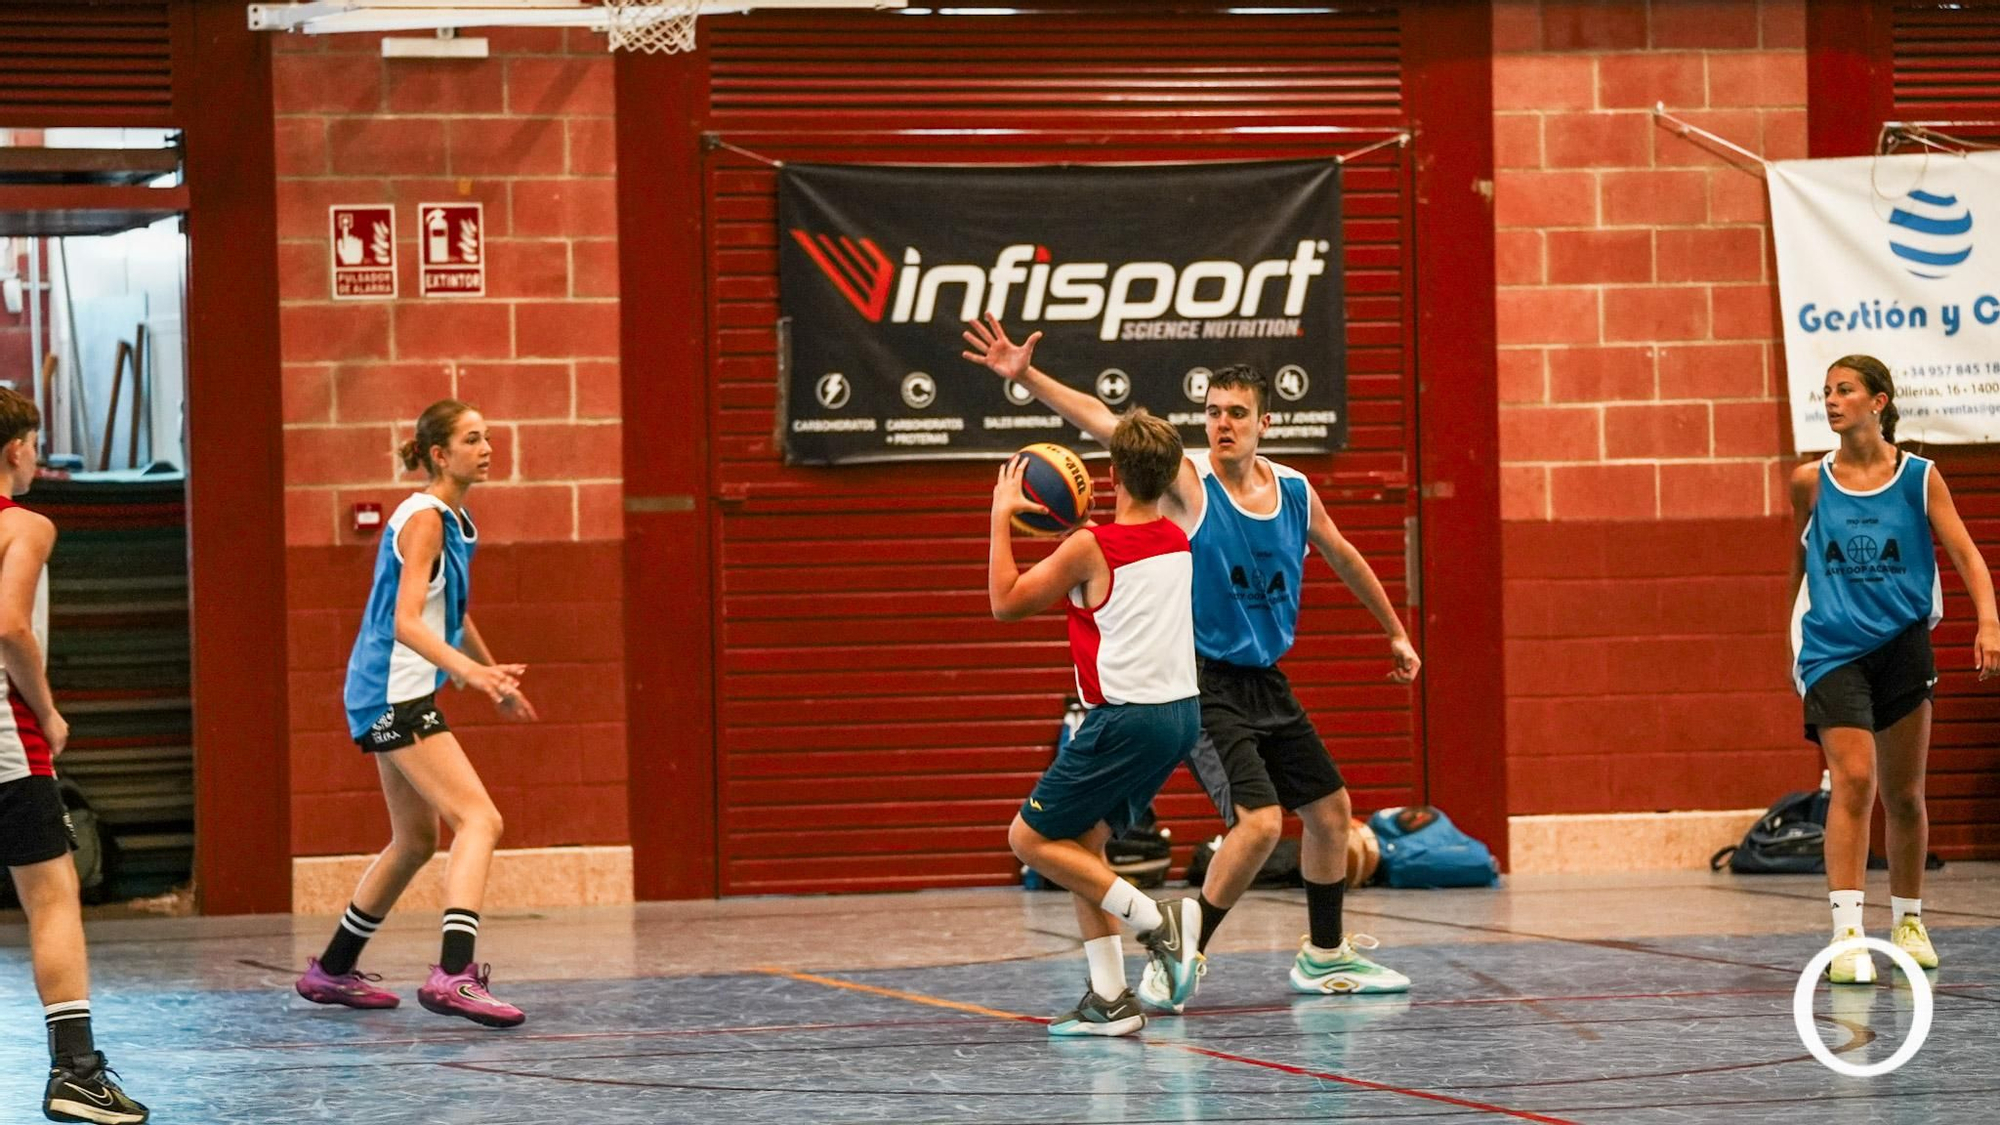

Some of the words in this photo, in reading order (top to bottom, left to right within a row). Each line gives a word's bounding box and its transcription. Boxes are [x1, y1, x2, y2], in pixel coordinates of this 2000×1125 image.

[338, 272, 391, 284] PULSADOR
[426, 272, 480, 289] EXTINTOR
[353, 283, 391, 293] ALARMA
[891, 240, 1325, 341] infisport
[1798, 299, 1928, 333] Gestión
[1942, 303, 1961, 337] y
[1121, 320, 1201, 341] SCIENCE
